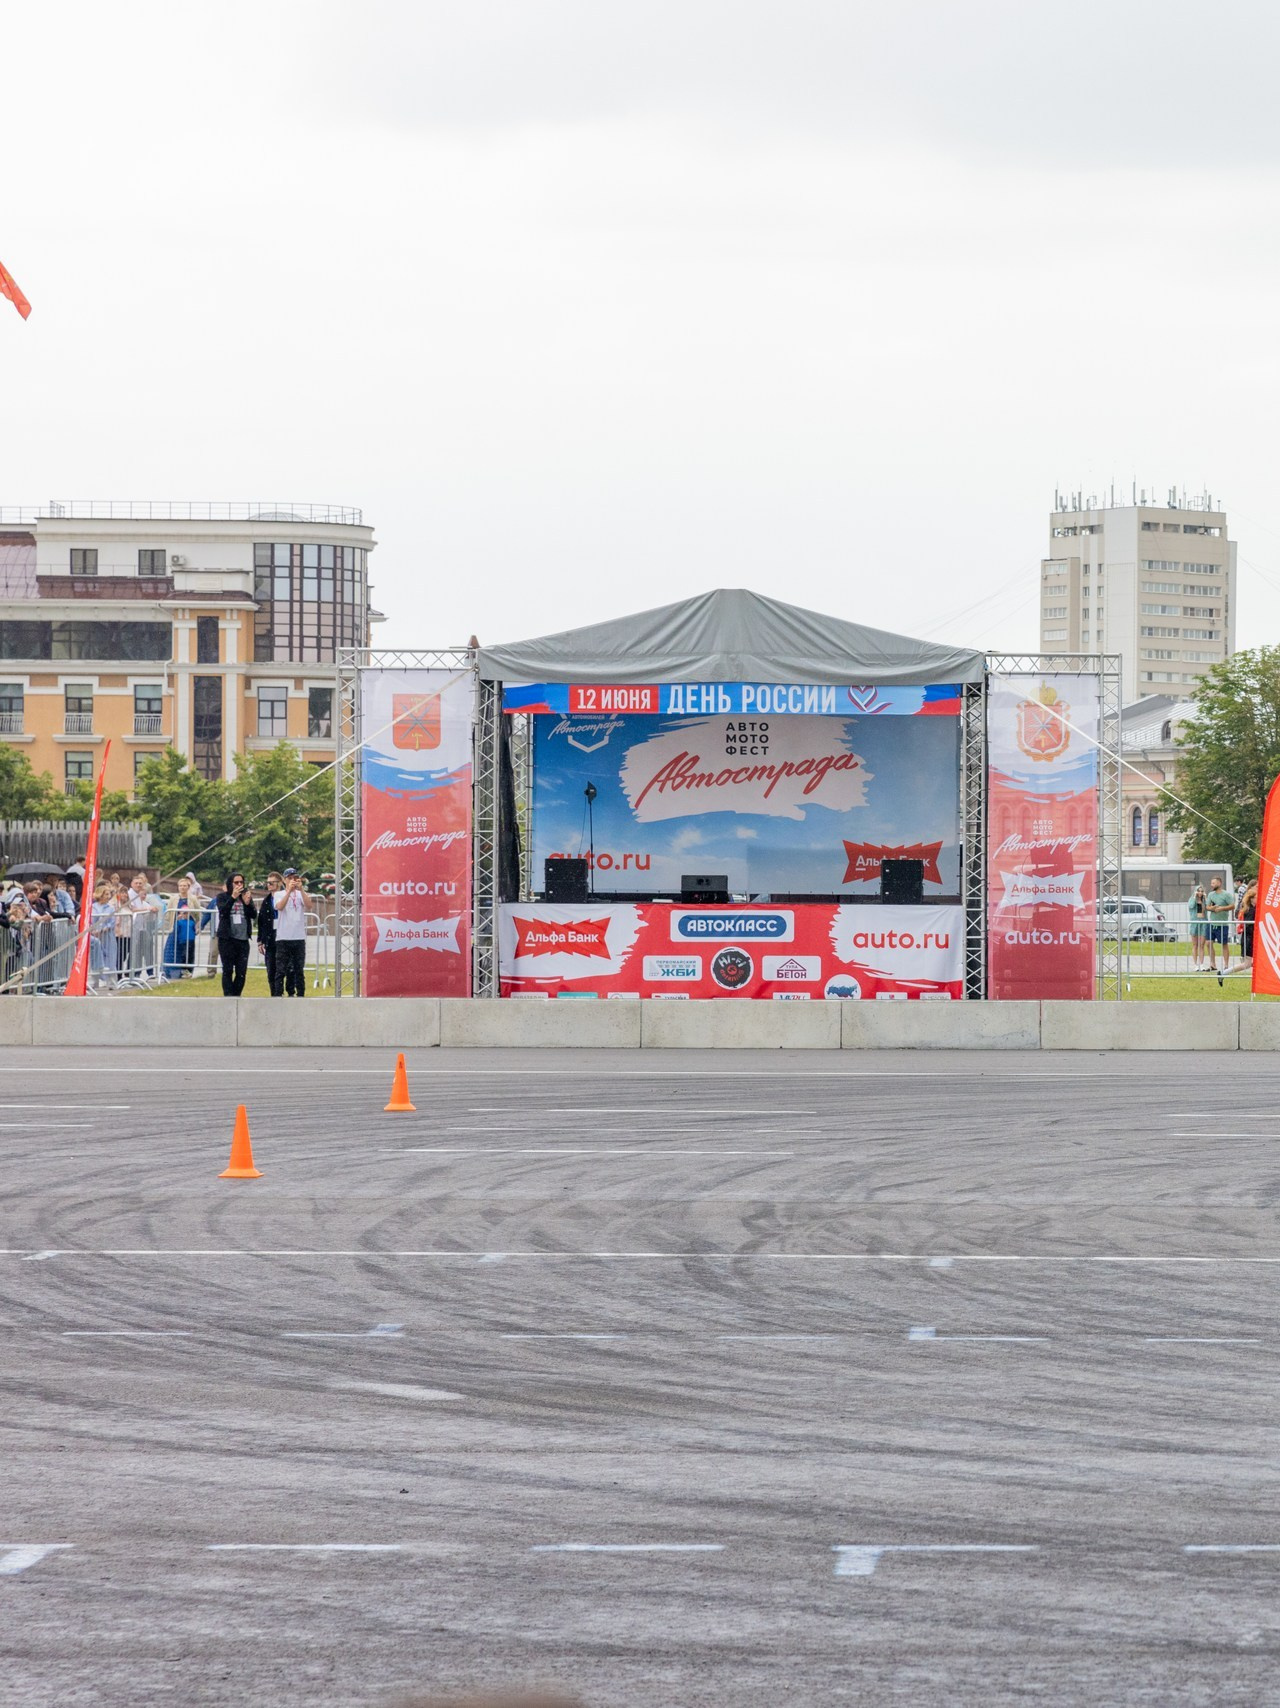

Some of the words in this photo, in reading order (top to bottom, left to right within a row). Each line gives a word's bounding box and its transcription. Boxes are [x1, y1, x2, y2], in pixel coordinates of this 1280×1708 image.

[577, 688, 597, 710] 12
[601, 688, 651, 710] ИЮНЯ
[667, 684, 732, 714] ДЕНЬ
[741, 684, 837, 713] РОССИИ
[547, 719, 626, 741] Автострада
[725, 722, 770, 732] АВТО
[725, 734, 770, 743] МОТО
[725, 746, 770, 756] ФЕСТ
[634, 751, 860, 810] Автострада
[366, 830, 468, 857] Автострада
[993, 833, 1093, 859] Автострада
[379, 880, 456, 895] auto.ru
[1011, 884, 1046, 896] Альфа
[1048, 884, 1074, 893] Банк
[686, 919, 778, 932] АВТОКЛАСС
[385, 929, 420, 941] Альфа
[423, 929, 449, 938] Банк
[525, 931, 566, 945] Альфа
[568, 931, 599, 943] Банк
[853, 929, 950, 949] auto.ru
[1005, 928, 1080, 945] auto.ru
